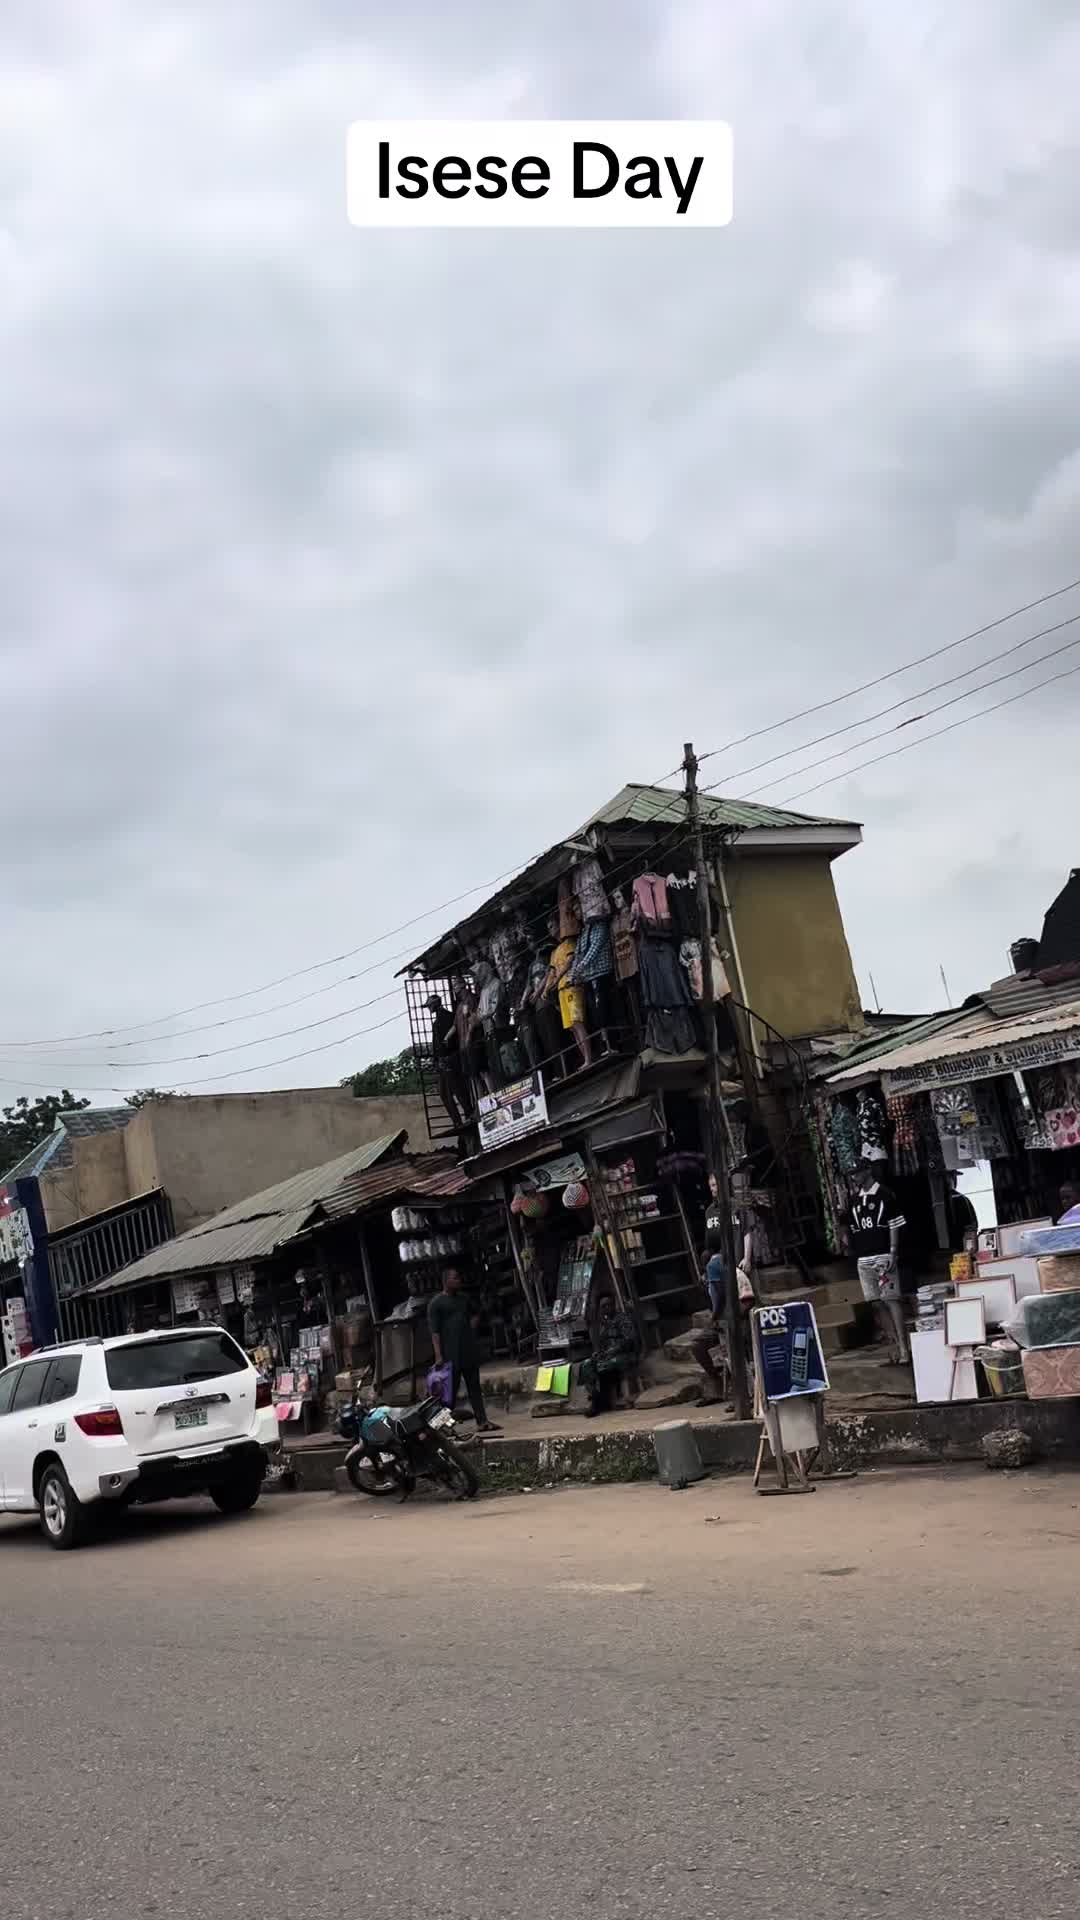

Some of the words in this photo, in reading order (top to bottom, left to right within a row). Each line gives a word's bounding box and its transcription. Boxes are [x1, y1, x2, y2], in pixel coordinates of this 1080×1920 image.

[935, 1053, 991, 1076] BOOKSHOP
[994, 1051, 1003, 1065] &
[860, 1216, 874, 1231] 08
[760, 1308, 787, 1328] POS
